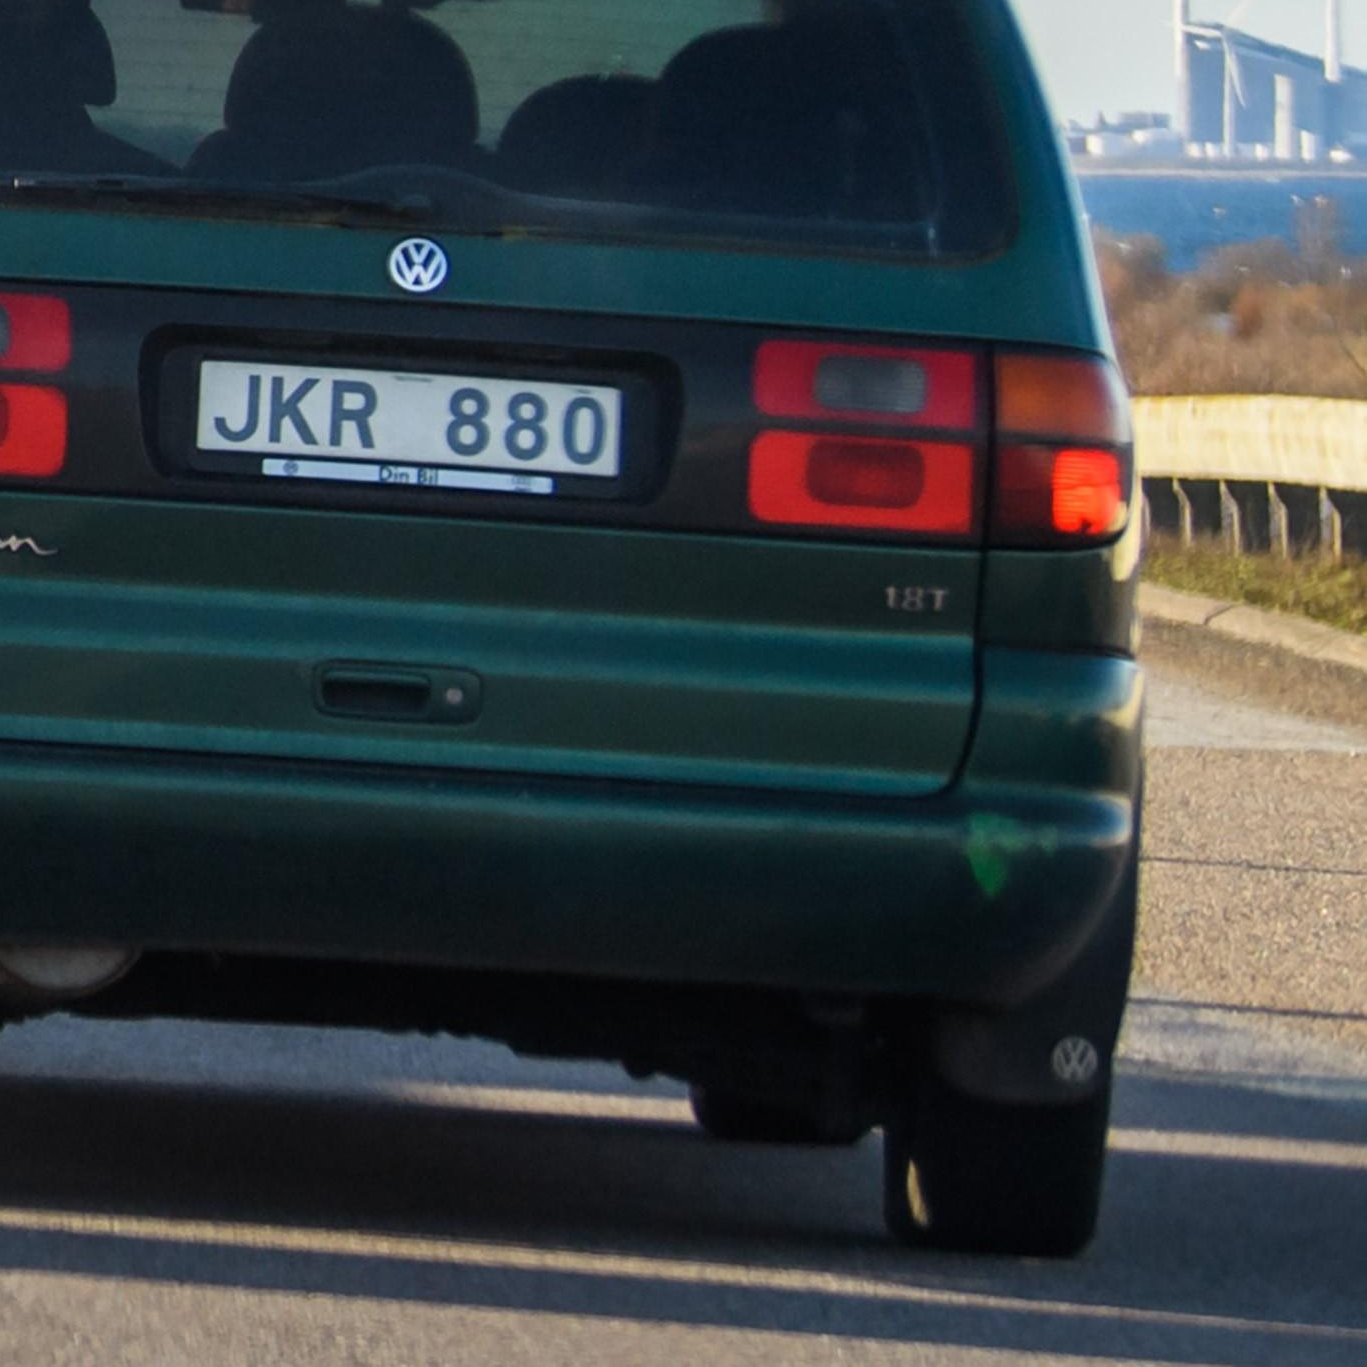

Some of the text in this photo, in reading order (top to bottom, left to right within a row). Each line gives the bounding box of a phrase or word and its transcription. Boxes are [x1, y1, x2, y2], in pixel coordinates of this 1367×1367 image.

[213, 374, 606, 465] JKR 880
[376, 465, 439, 485] Din Bil
